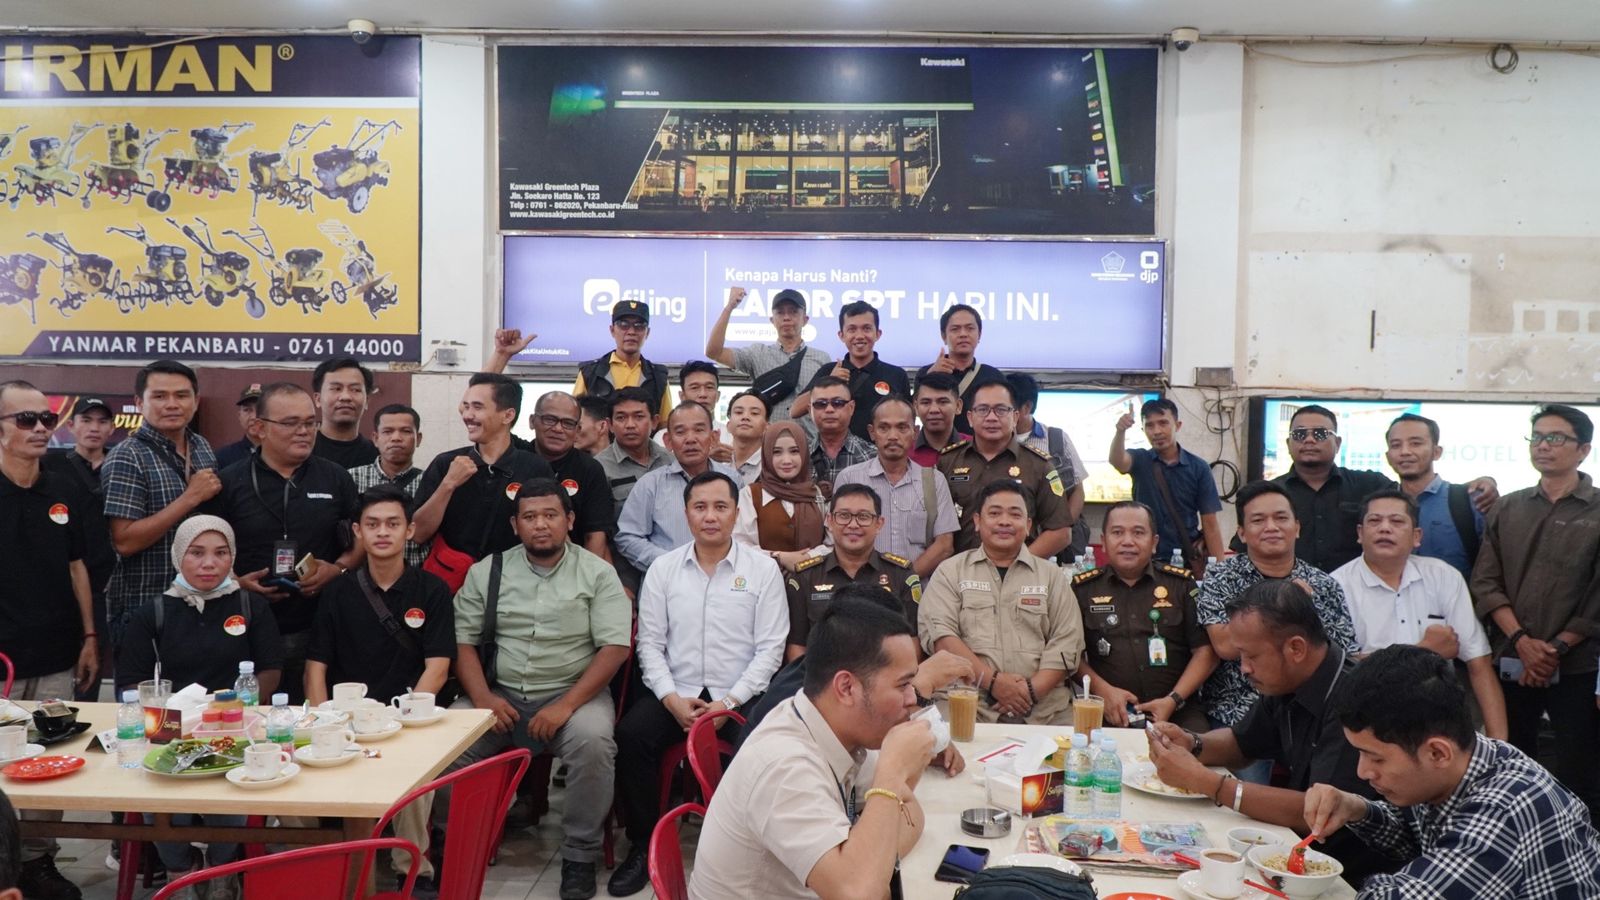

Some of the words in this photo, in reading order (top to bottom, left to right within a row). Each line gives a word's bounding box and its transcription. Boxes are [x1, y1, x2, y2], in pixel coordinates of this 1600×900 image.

[920, 57, 966, 67] Kawasaki
[509, 183, 543, 191] Kawasaki
[544, 183, 579, 191] Greentech
[580, 183, 600, 191] Plaza
[554, 192, 572, 200] Hatta
[573, 192, 586, 200] No.
[587, 192, 600, 200] 123
[530, 201, 547, 209] 0761
[509, 210, 616, 219] www.kawasakigreentech.co.id
[725, 268, 779, 284] Kenapa
[783, 269, 827, 283] Harus
[831, 269, 878, 283] Nanti?
[1140, 269, 1159, 284] djp
[918, 291, 995, 321] HARI
[1006, 292, 1059, 321] INI.
[49, 336, 137, 353] YANMAR
[145, 337, 264, 355] PEKANBARU
[288, 338, 334, 355] 0761
[343, 339, 404, 356] 44000
